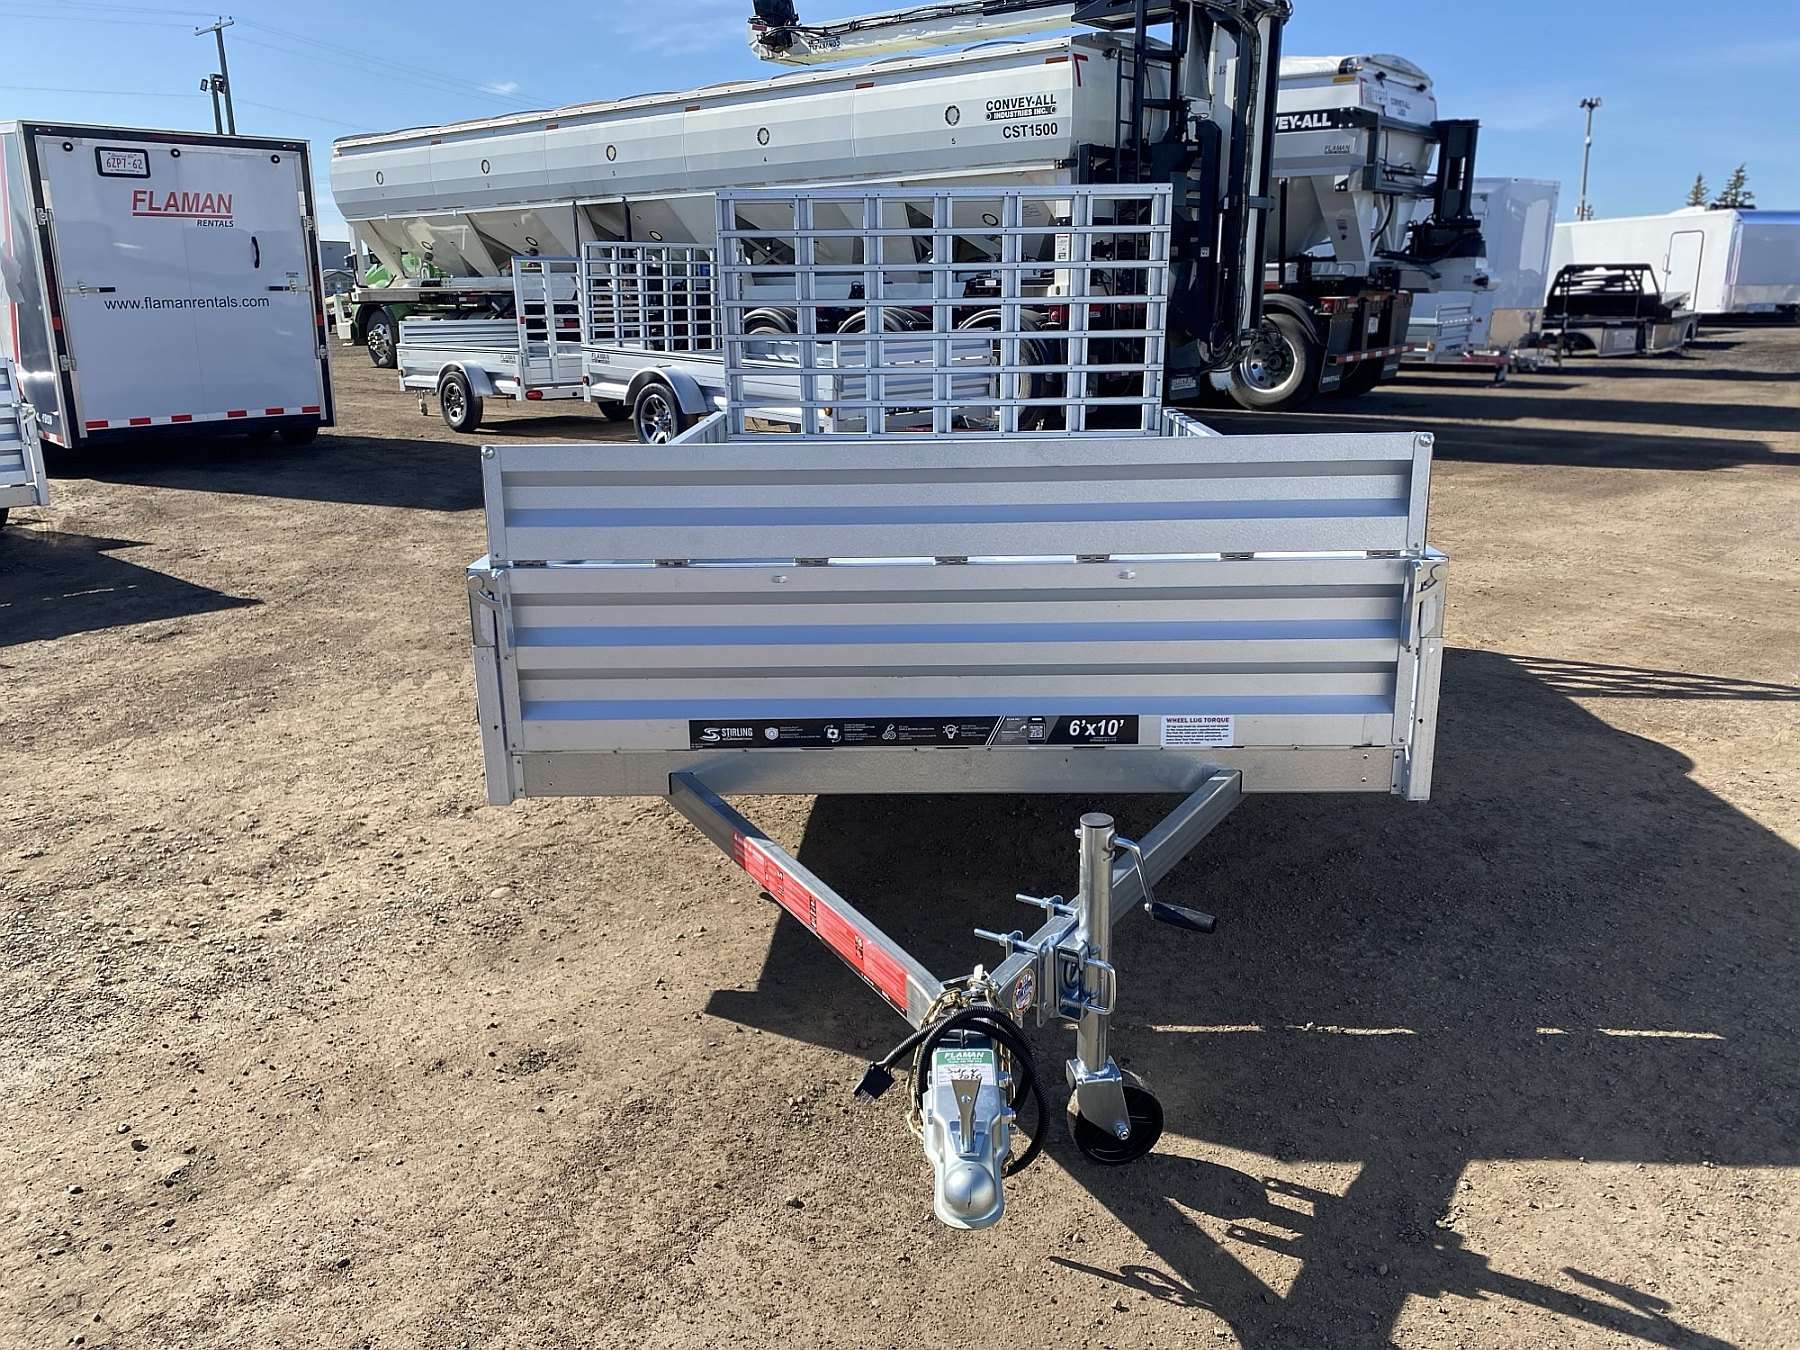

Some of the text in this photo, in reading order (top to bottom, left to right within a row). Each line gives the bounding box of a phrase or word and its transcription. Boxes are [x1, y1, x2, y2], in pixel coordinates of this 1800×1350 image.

[993, 107, 1048, 119] INDUSTRIES INC.
[1003, 122, 1058, 139] CST1500
[132, 190, 232, 214] FLAMAN
[196, 220, 234, 228] RENTALS
[103, 296, 270, 309] www.flamanrentals.com
[721, 727, 753, 738] STIRLING
[944, 1051, 985, 1059] FLAMAN
